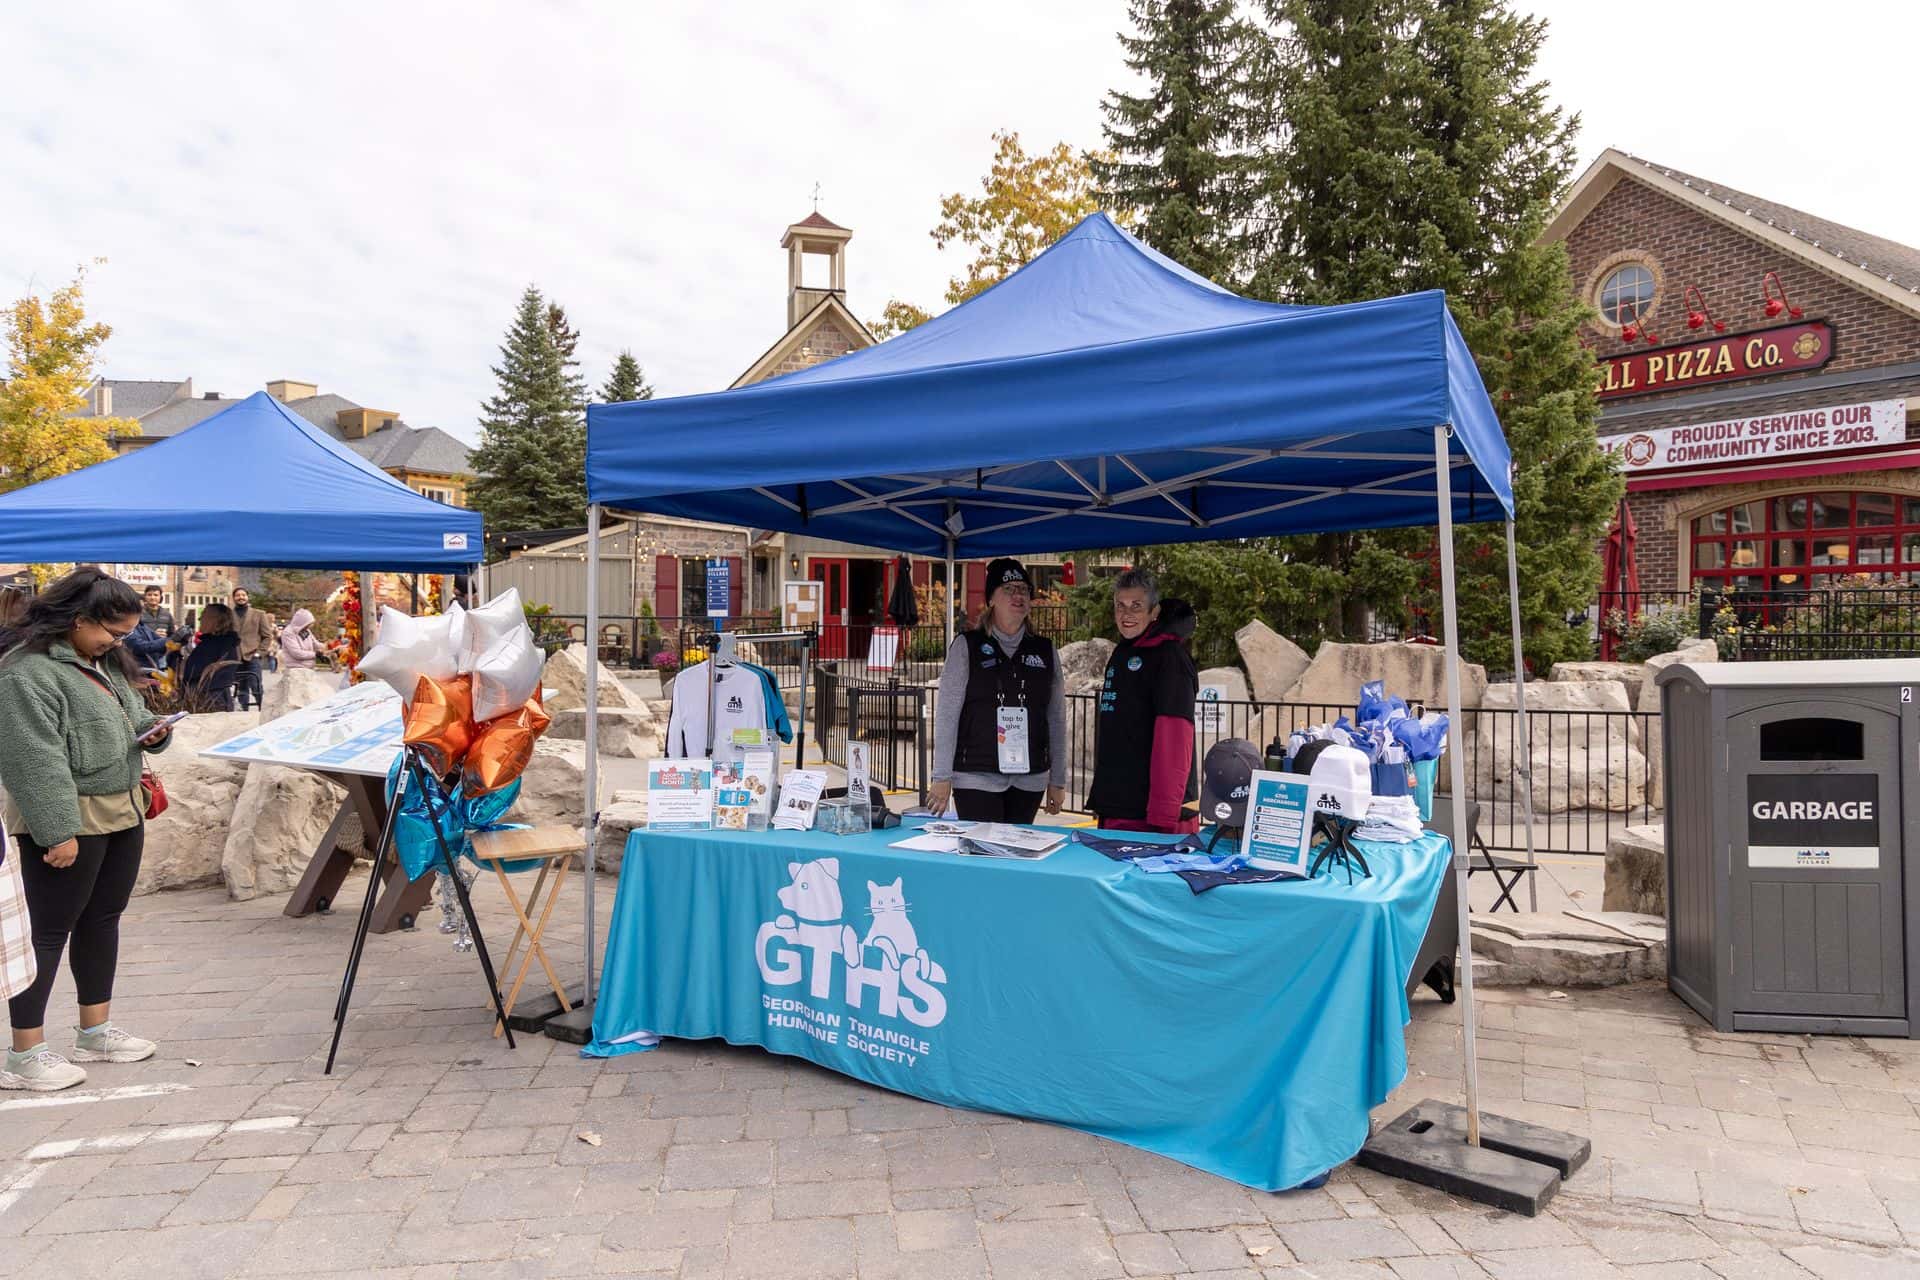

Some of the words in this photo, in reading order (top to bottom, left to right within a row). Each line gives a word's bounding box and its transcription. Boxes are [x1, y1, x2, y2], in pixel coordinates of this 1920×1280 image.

[1594, 361, 1636, 392] LL
[1647, 345, 1735, 385] PIZZA
[1745, 337, 1784, 367] Co.
[1667, 438, 1772, 463] COMMUNITY
[1775, 430, 1829, 452] SINCE
[1833, 425, 1879, 445] 2003.
[1671, 421, 1745, 445] PROUDLY
[1749, 411, 1826, 436] SERVING
[1831, 405, 1872, 427] OUR
[1902, 688, 1910, 702] 2
[1316, 800, 1341, 810] GTHS
[1752, 801, 1873, 820] GARBAGE
[755, 921, 947, 1028] GTHS
[762, 994, 841, 1028] GEORGIAN
[848, 1016, 930, 1055] TRIANGLE
[767, 1012, 838, 1044] HUMANE
[847, 1033, 916, 1067] SOCIETY
